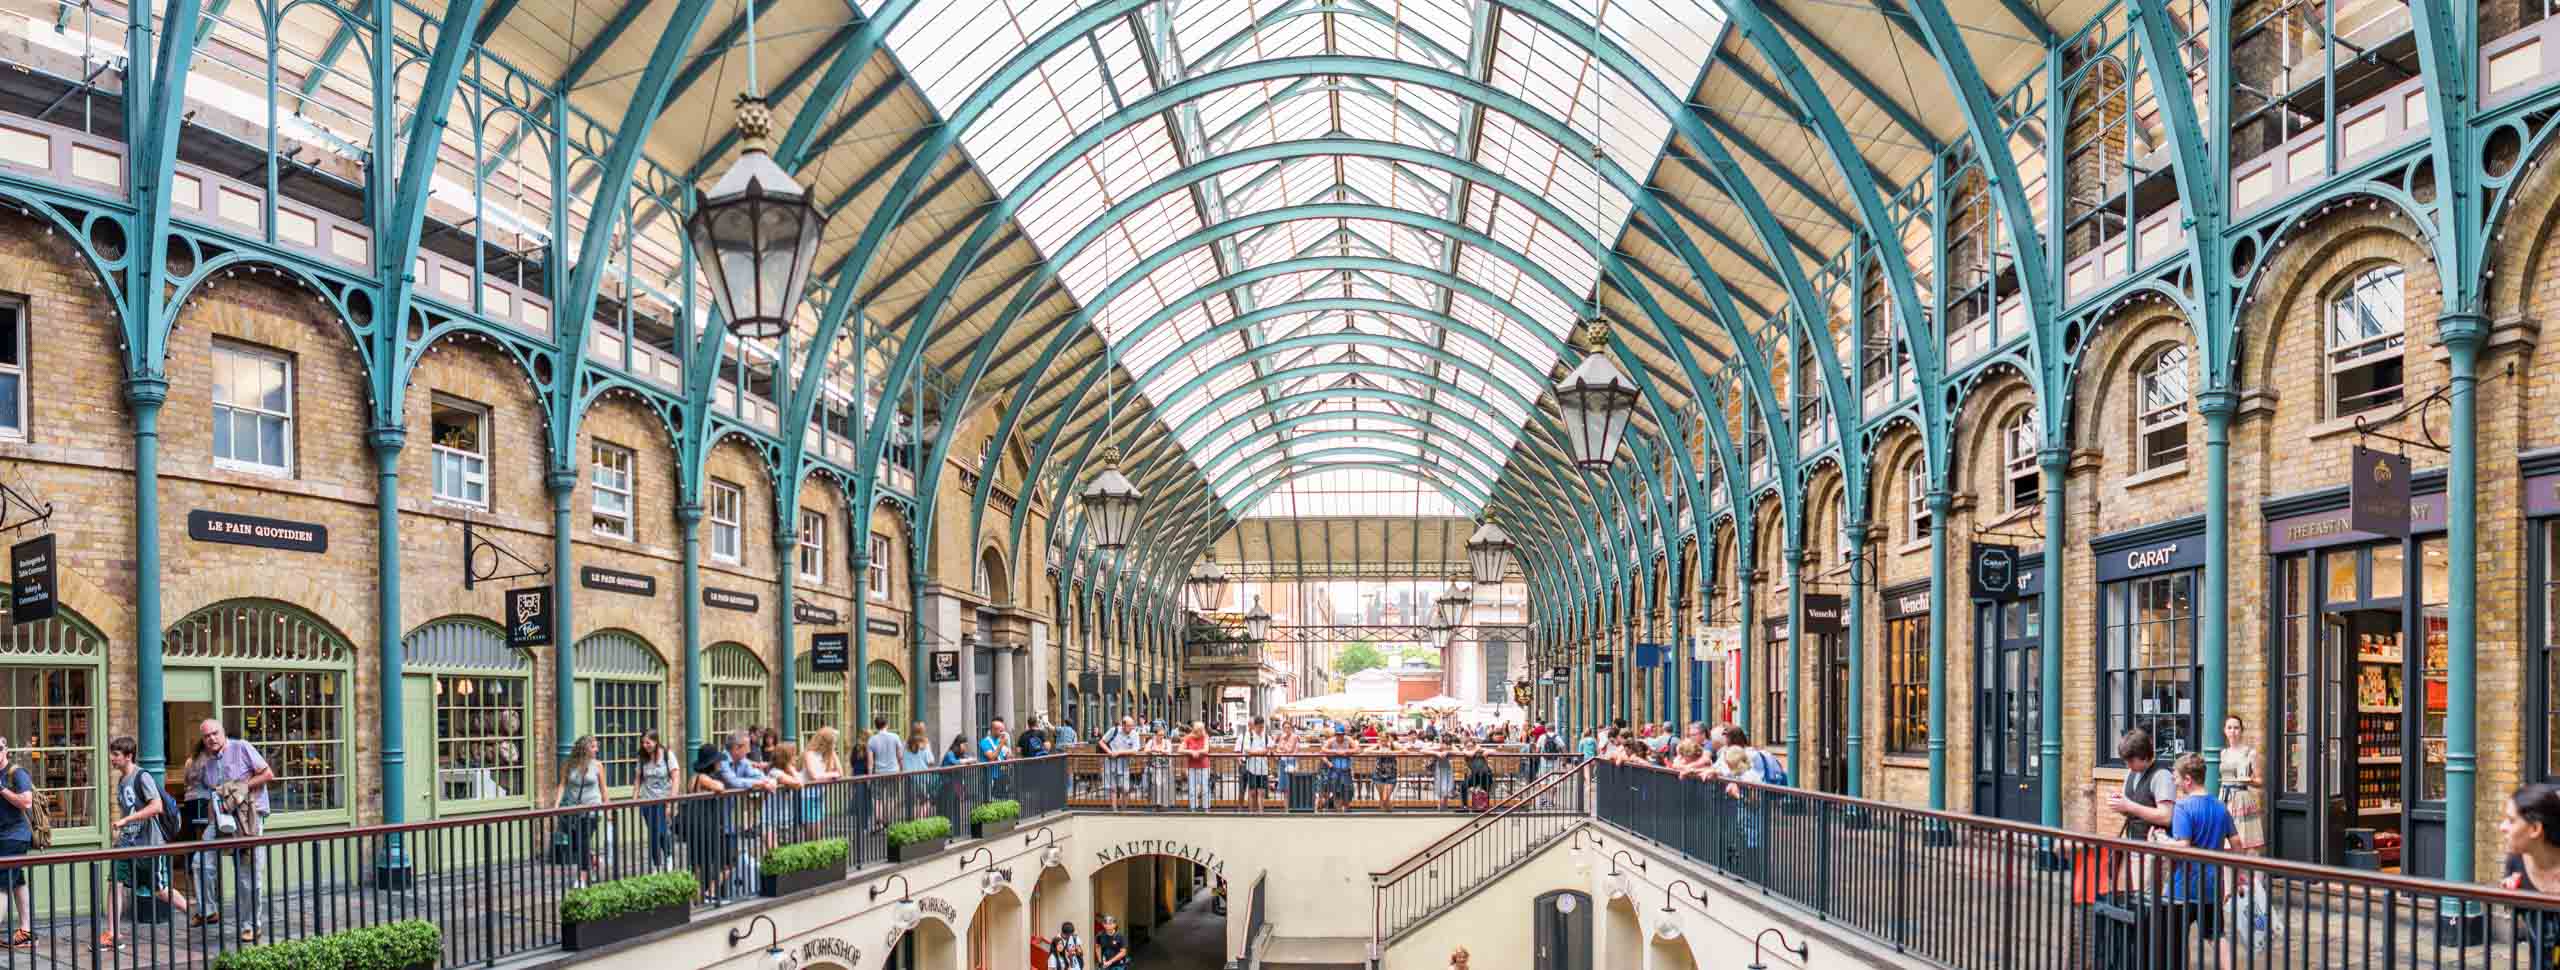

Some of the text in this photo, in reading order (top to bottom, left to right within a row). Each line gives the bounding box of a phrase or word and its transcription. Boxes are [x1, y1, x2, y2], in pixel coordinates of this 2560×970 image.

[208, 521, 313, 541] LE PAIN QUOTIDIEN
[2288, 524, 2307, 540] THE
[1808, 609, 1837, 618] Venchi
[1900, 592, 1929, 614] Venchi
[1096, 840, 1224, 873] NAUTICALIA
[919, 896, 957, 924] WORKSHOP
[804, 938, 861, 966] WORKSHOP
